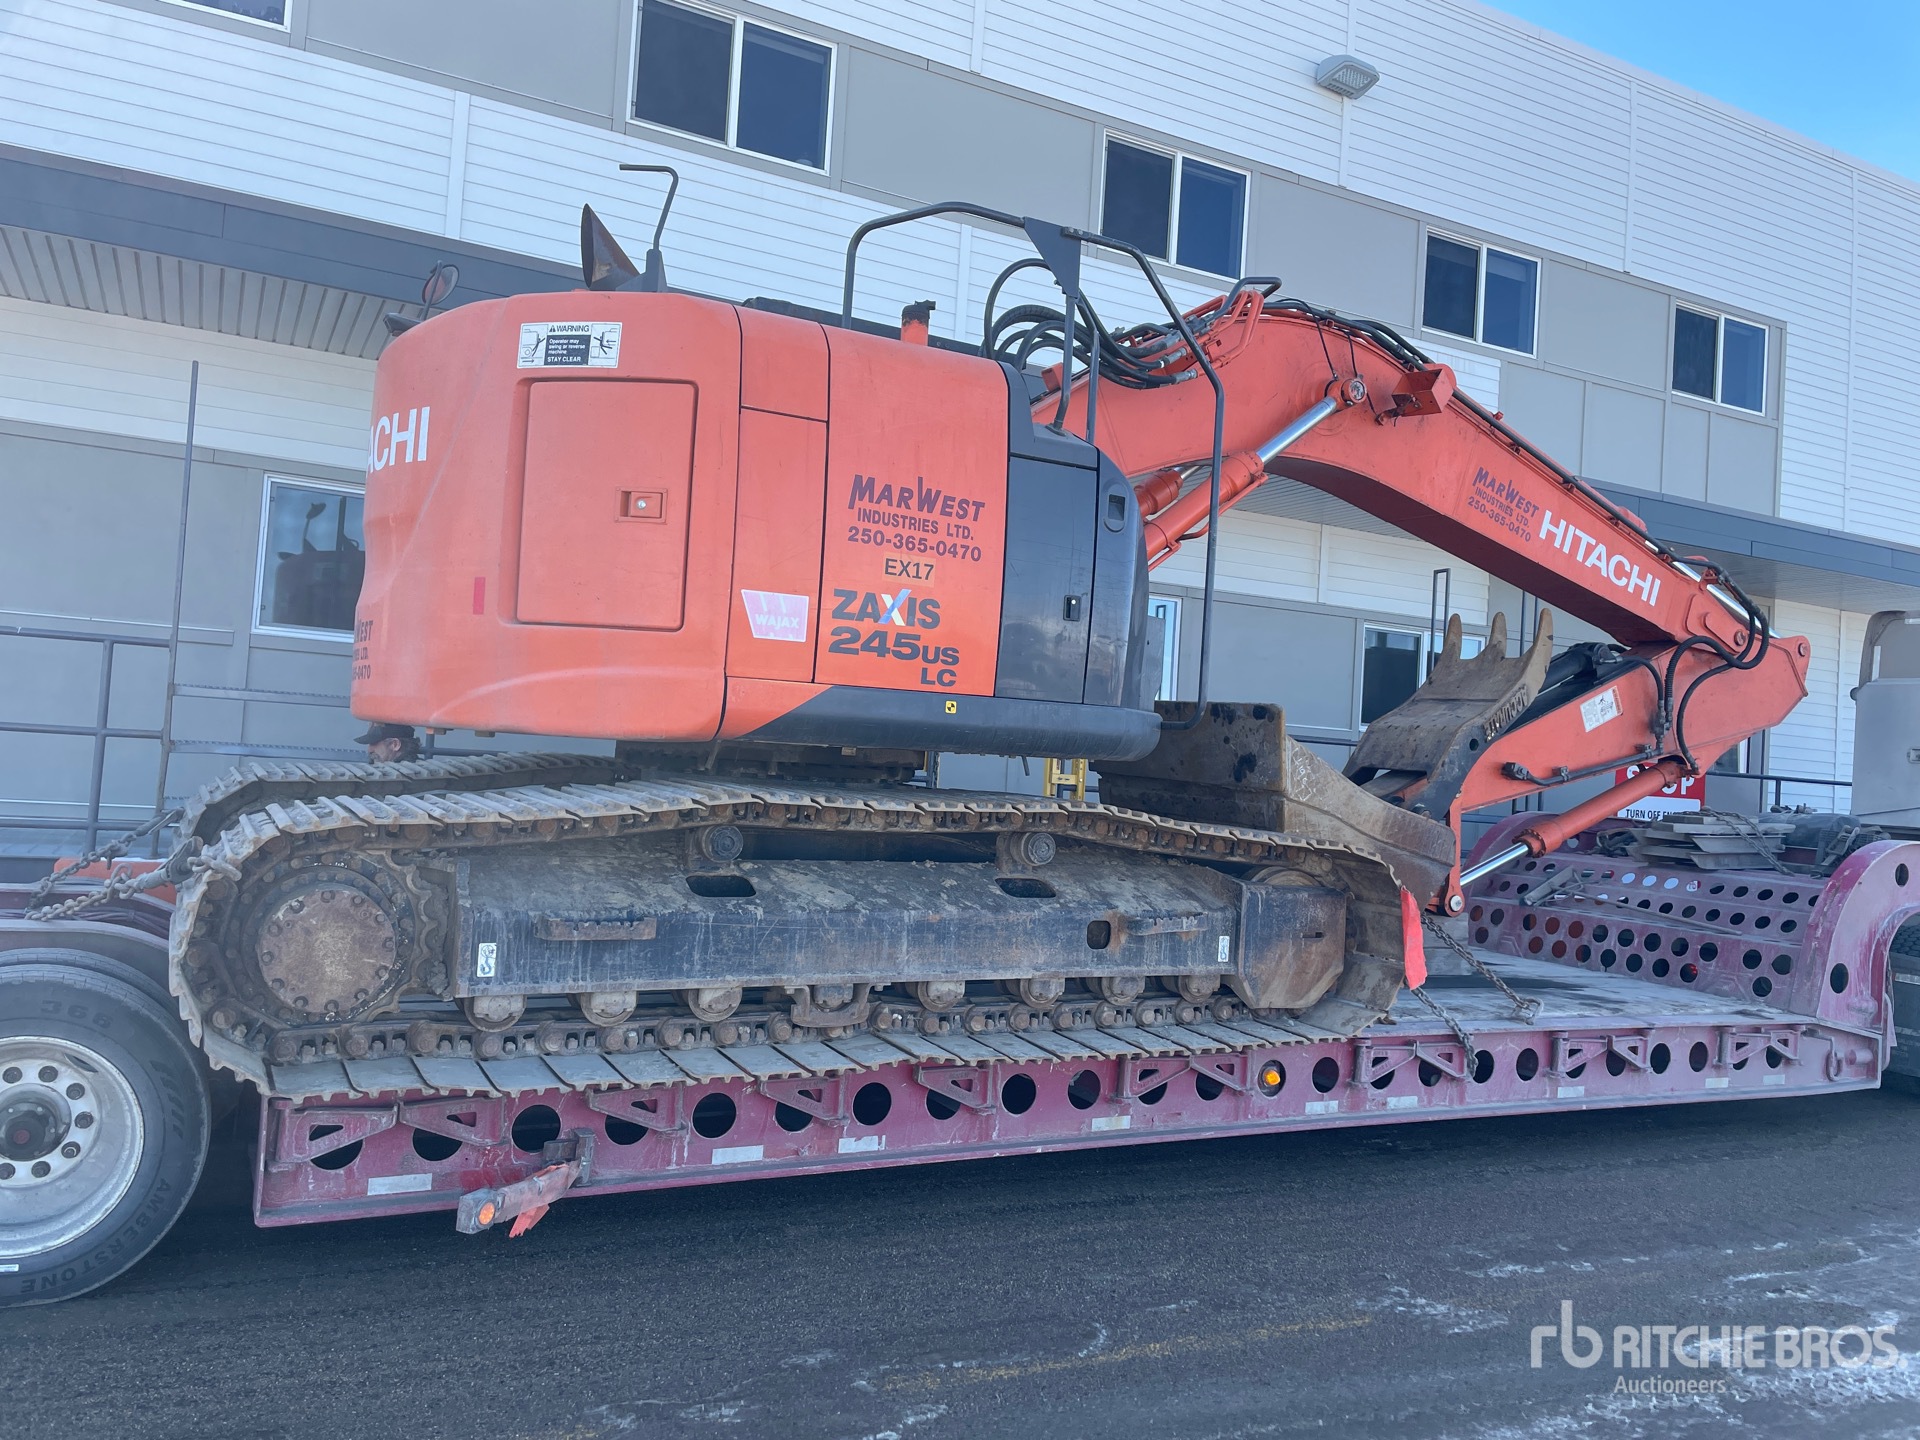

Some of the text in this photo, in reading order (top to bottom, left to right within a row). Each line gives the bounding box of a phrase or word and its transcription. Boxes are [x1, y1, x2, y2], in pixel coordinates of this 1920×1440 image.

[556, 324, 590, 333] WARNING
[366, 406, 430, 479] ACHI
[848, 473, 985, 522] MARWEST
[1475, 486, 1514, 518] INDUSTRIES
[857, 507, 974, 541] INDUSTRIES LTD.
[1468, 496, 1531, 543] 250-365-0470
[847, 526, 982, 562] 250-365-0470
[1539, 509, 1661, 607] HITACHI
[884, 558, 934, 581] EX17
[755, 613, 800, 631] WAJAX
[831, 588, 941, 630] ZAXIS
[920, 667, 958, 688] LC
[1626, 809, 1645, 819] TURN
[1647, 810, 1661, 820] OFF
